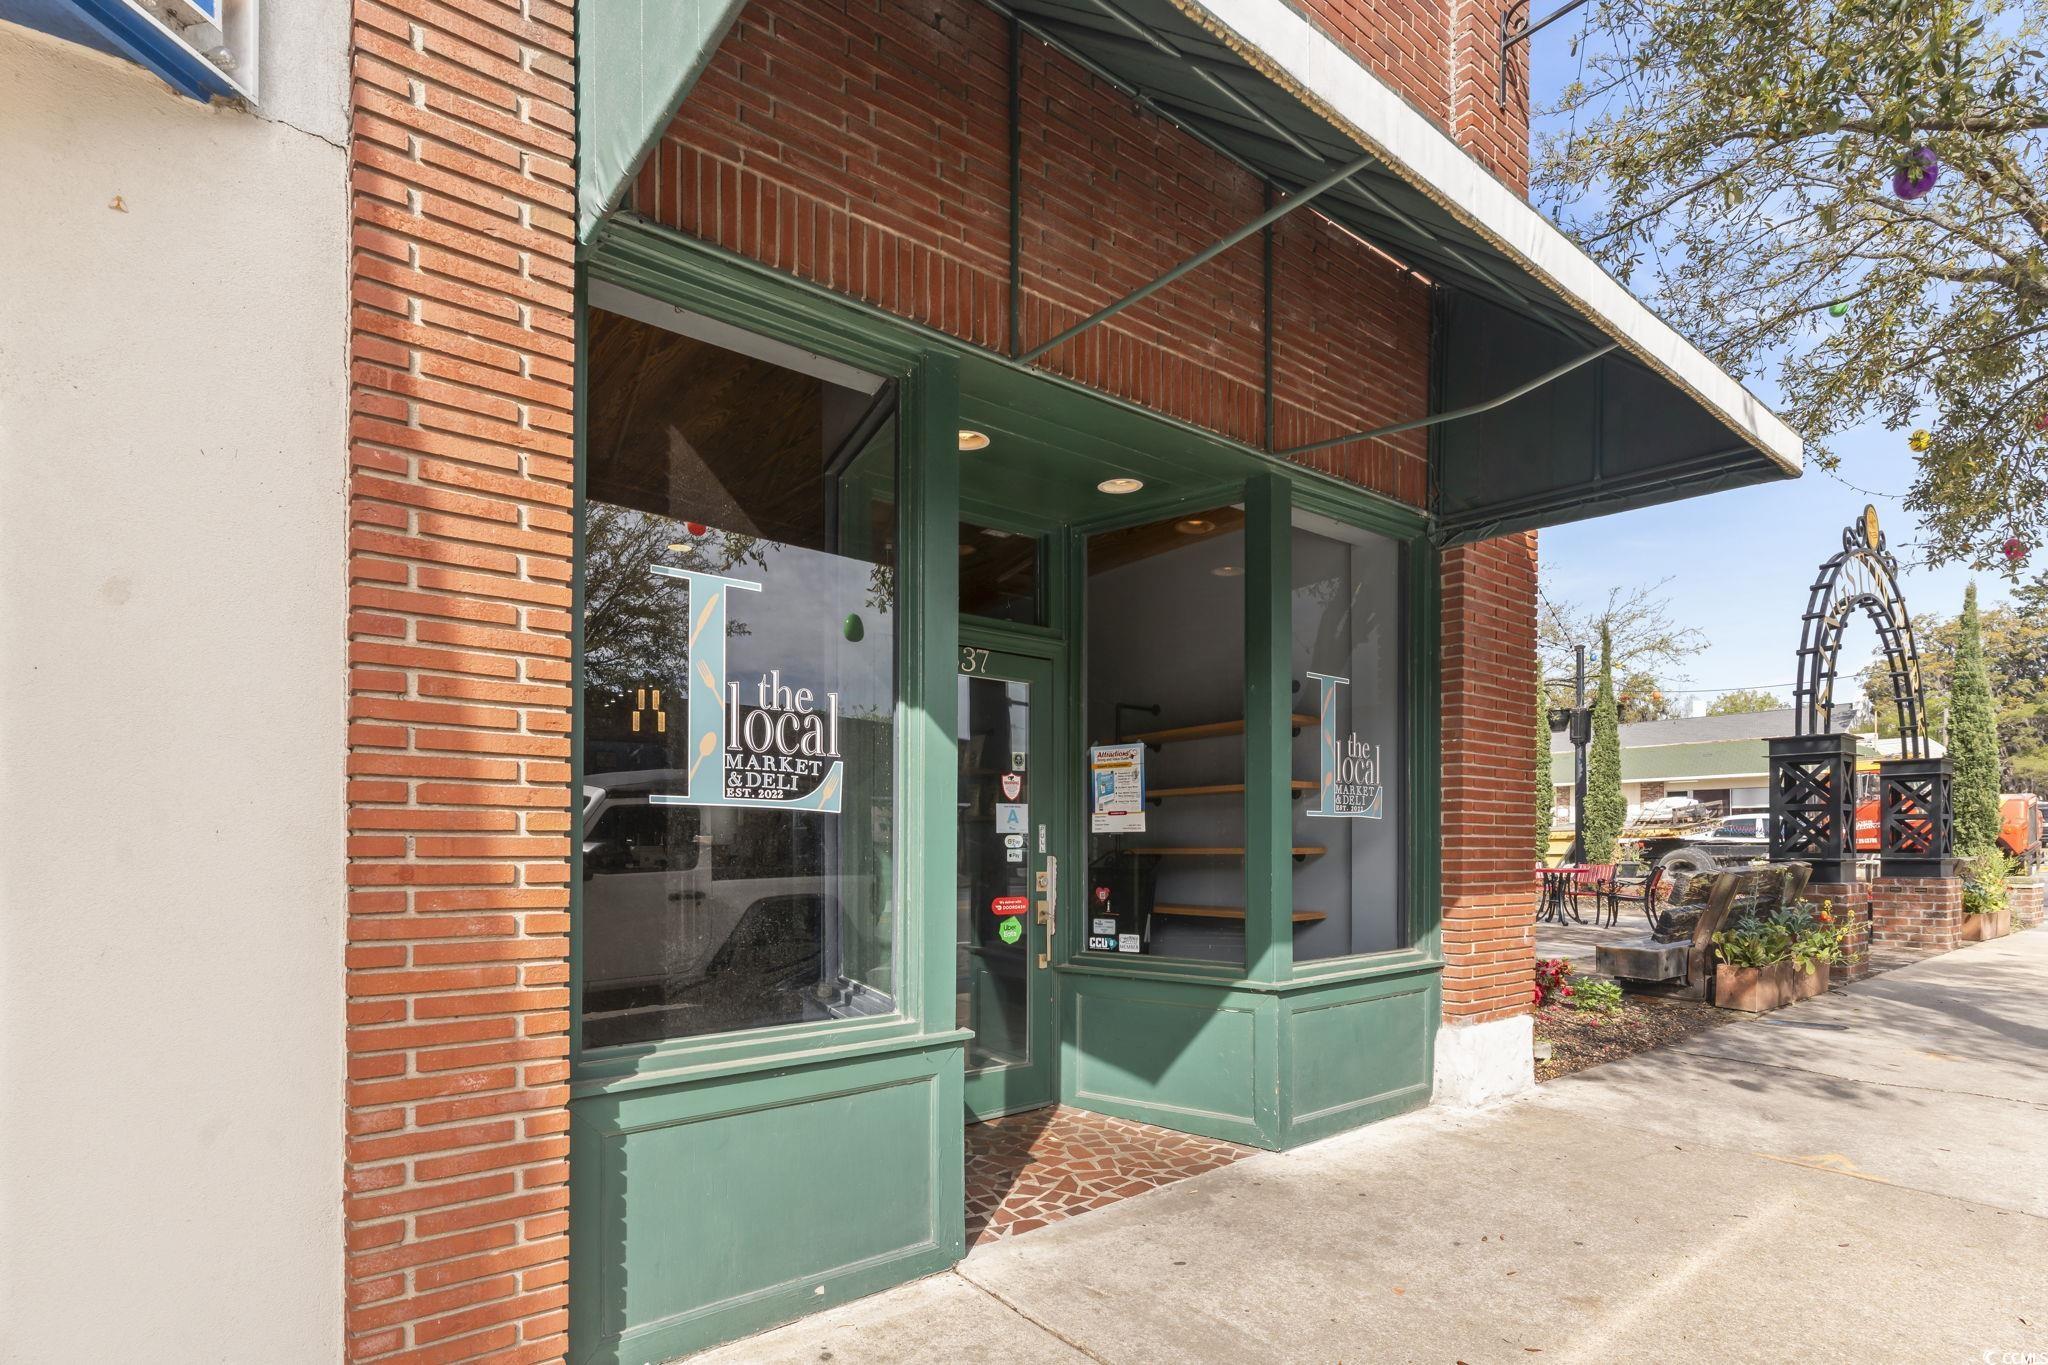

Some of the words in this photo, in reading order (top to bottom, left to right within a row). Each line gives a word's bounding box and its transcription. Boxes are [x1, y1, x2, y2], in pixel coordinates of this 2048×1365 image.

[958, 647, 990, 673] 37
[757, 669, 814, 714] the
[726, 681, 841, 757] local
[1348, 732, 1370, 759] the
[725, 753, 822, 776] MARKET
[1335, 739, 1381, 786] local
[726, 788, 755, 798] EST.
[758, 789, 784, 799] 2022
[1335, 784, 1375, 797] MARKET
[1007, 809, 1019, 823] A
